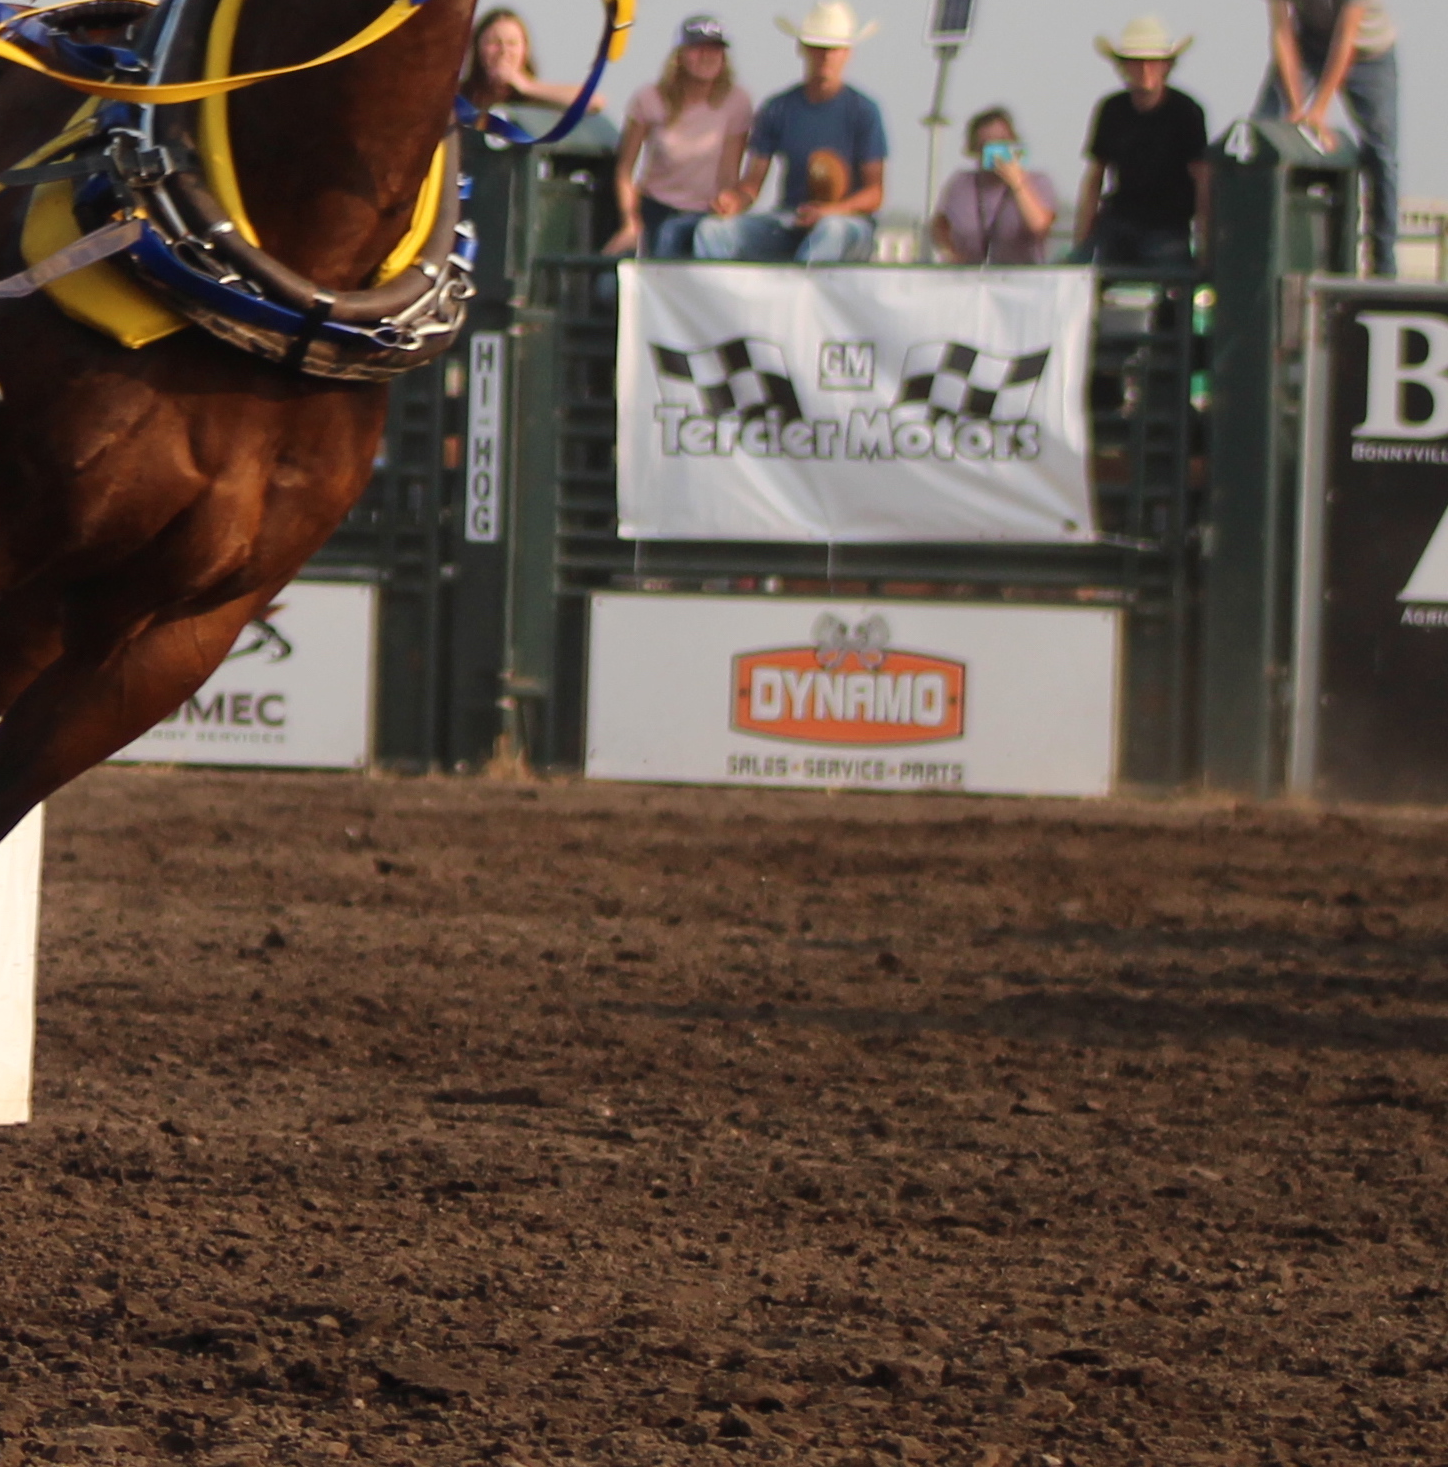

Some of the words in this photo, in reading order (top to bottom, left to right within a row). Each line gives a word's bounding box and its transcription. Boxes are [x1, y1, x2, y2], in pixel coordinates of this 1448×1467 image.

[1224, 123, 1252, 163] 4
[822, 343, 872, 380] GM
[655, 405, 840, 458] Tercier
[845, 407, 1041, 462] Motors
[750, 666, 946, 727] DYNAMO
